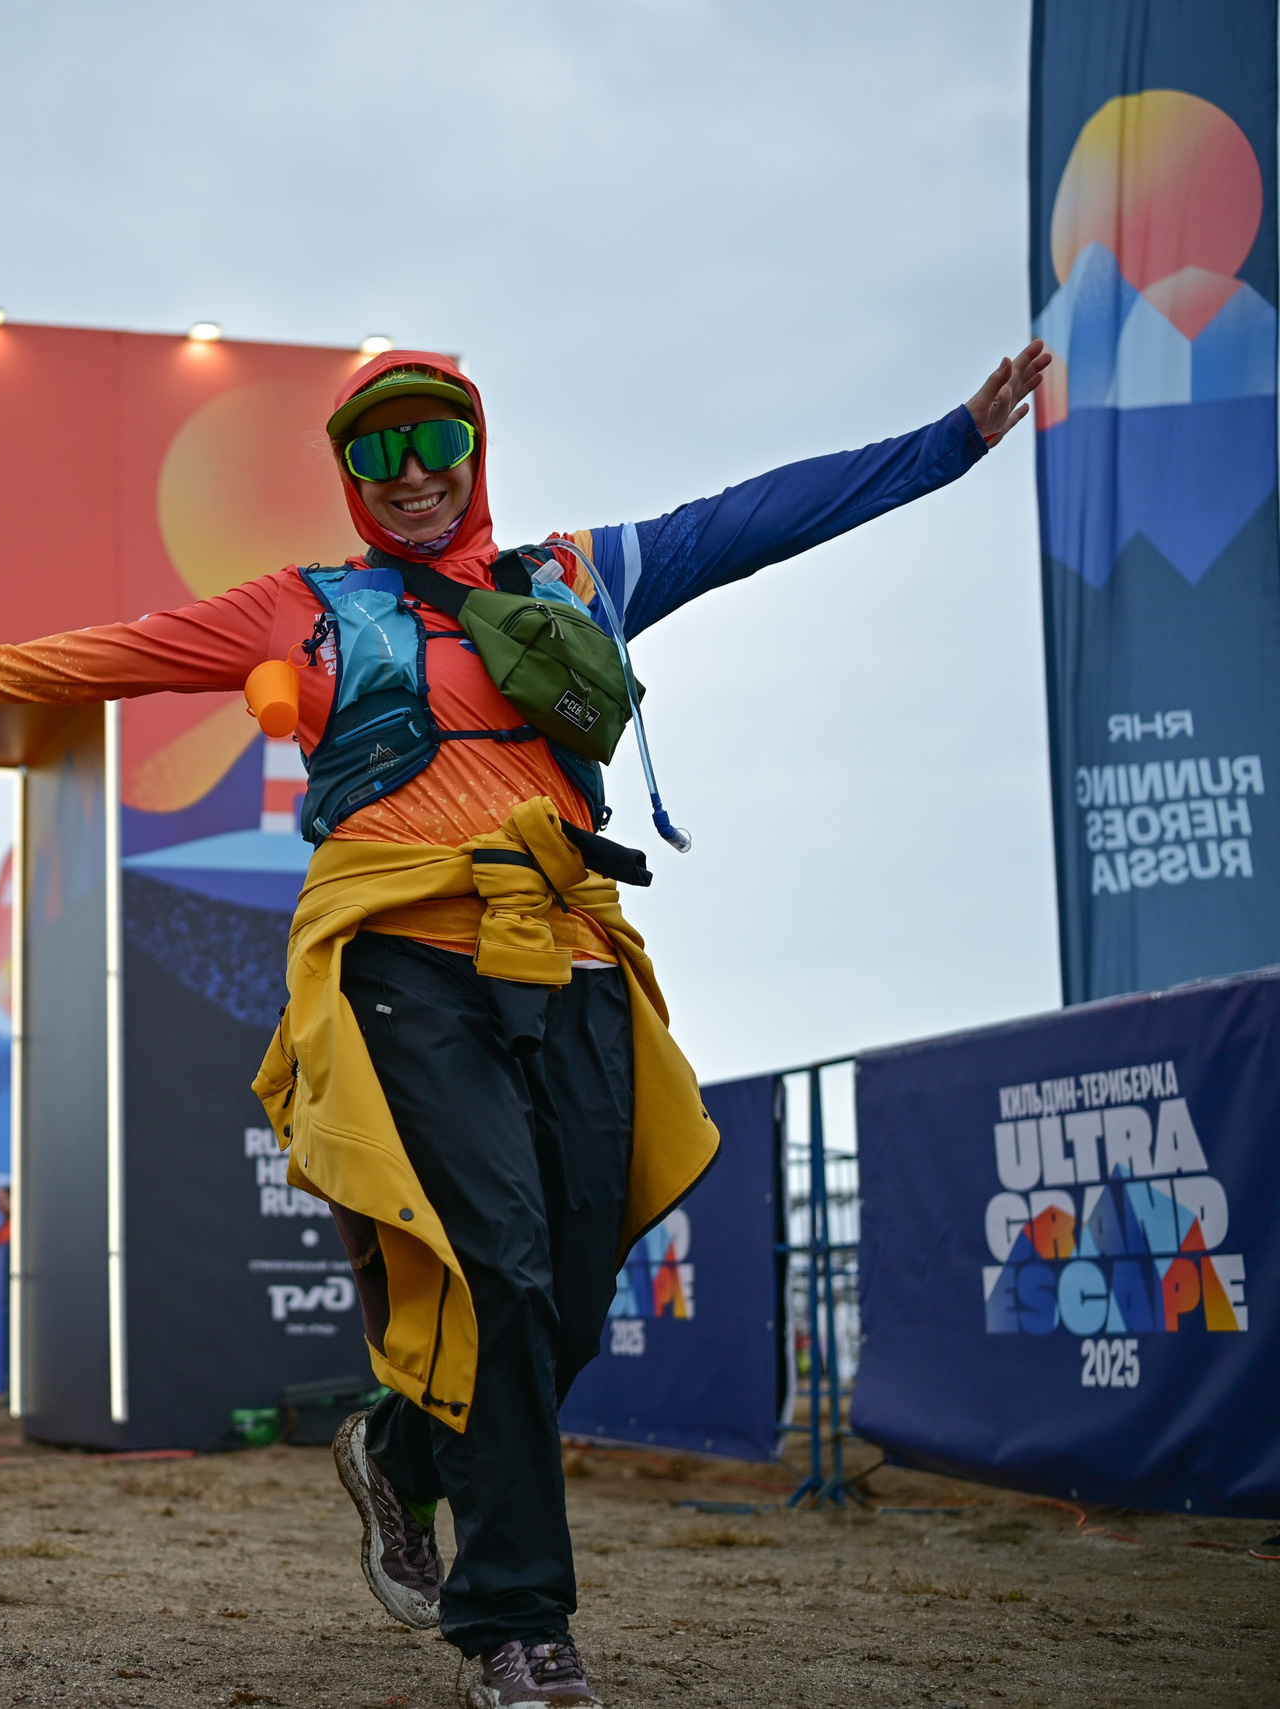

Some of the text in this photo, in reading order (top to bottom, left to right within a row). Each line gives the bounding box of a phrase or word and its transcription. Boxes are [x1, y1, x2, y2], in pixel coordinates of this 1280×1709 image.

[999, 1060, 1179, 1120] КИЛЬДИН-ТЕРИБЕРКА
[994, 1097, 1209, 1192] ULTRA
[985, 1175, 1229, 1265] GRAND
[982, 1254, 1248, 1335] ESCAPE
[1081, 1338, 1141, 1388] 2025
